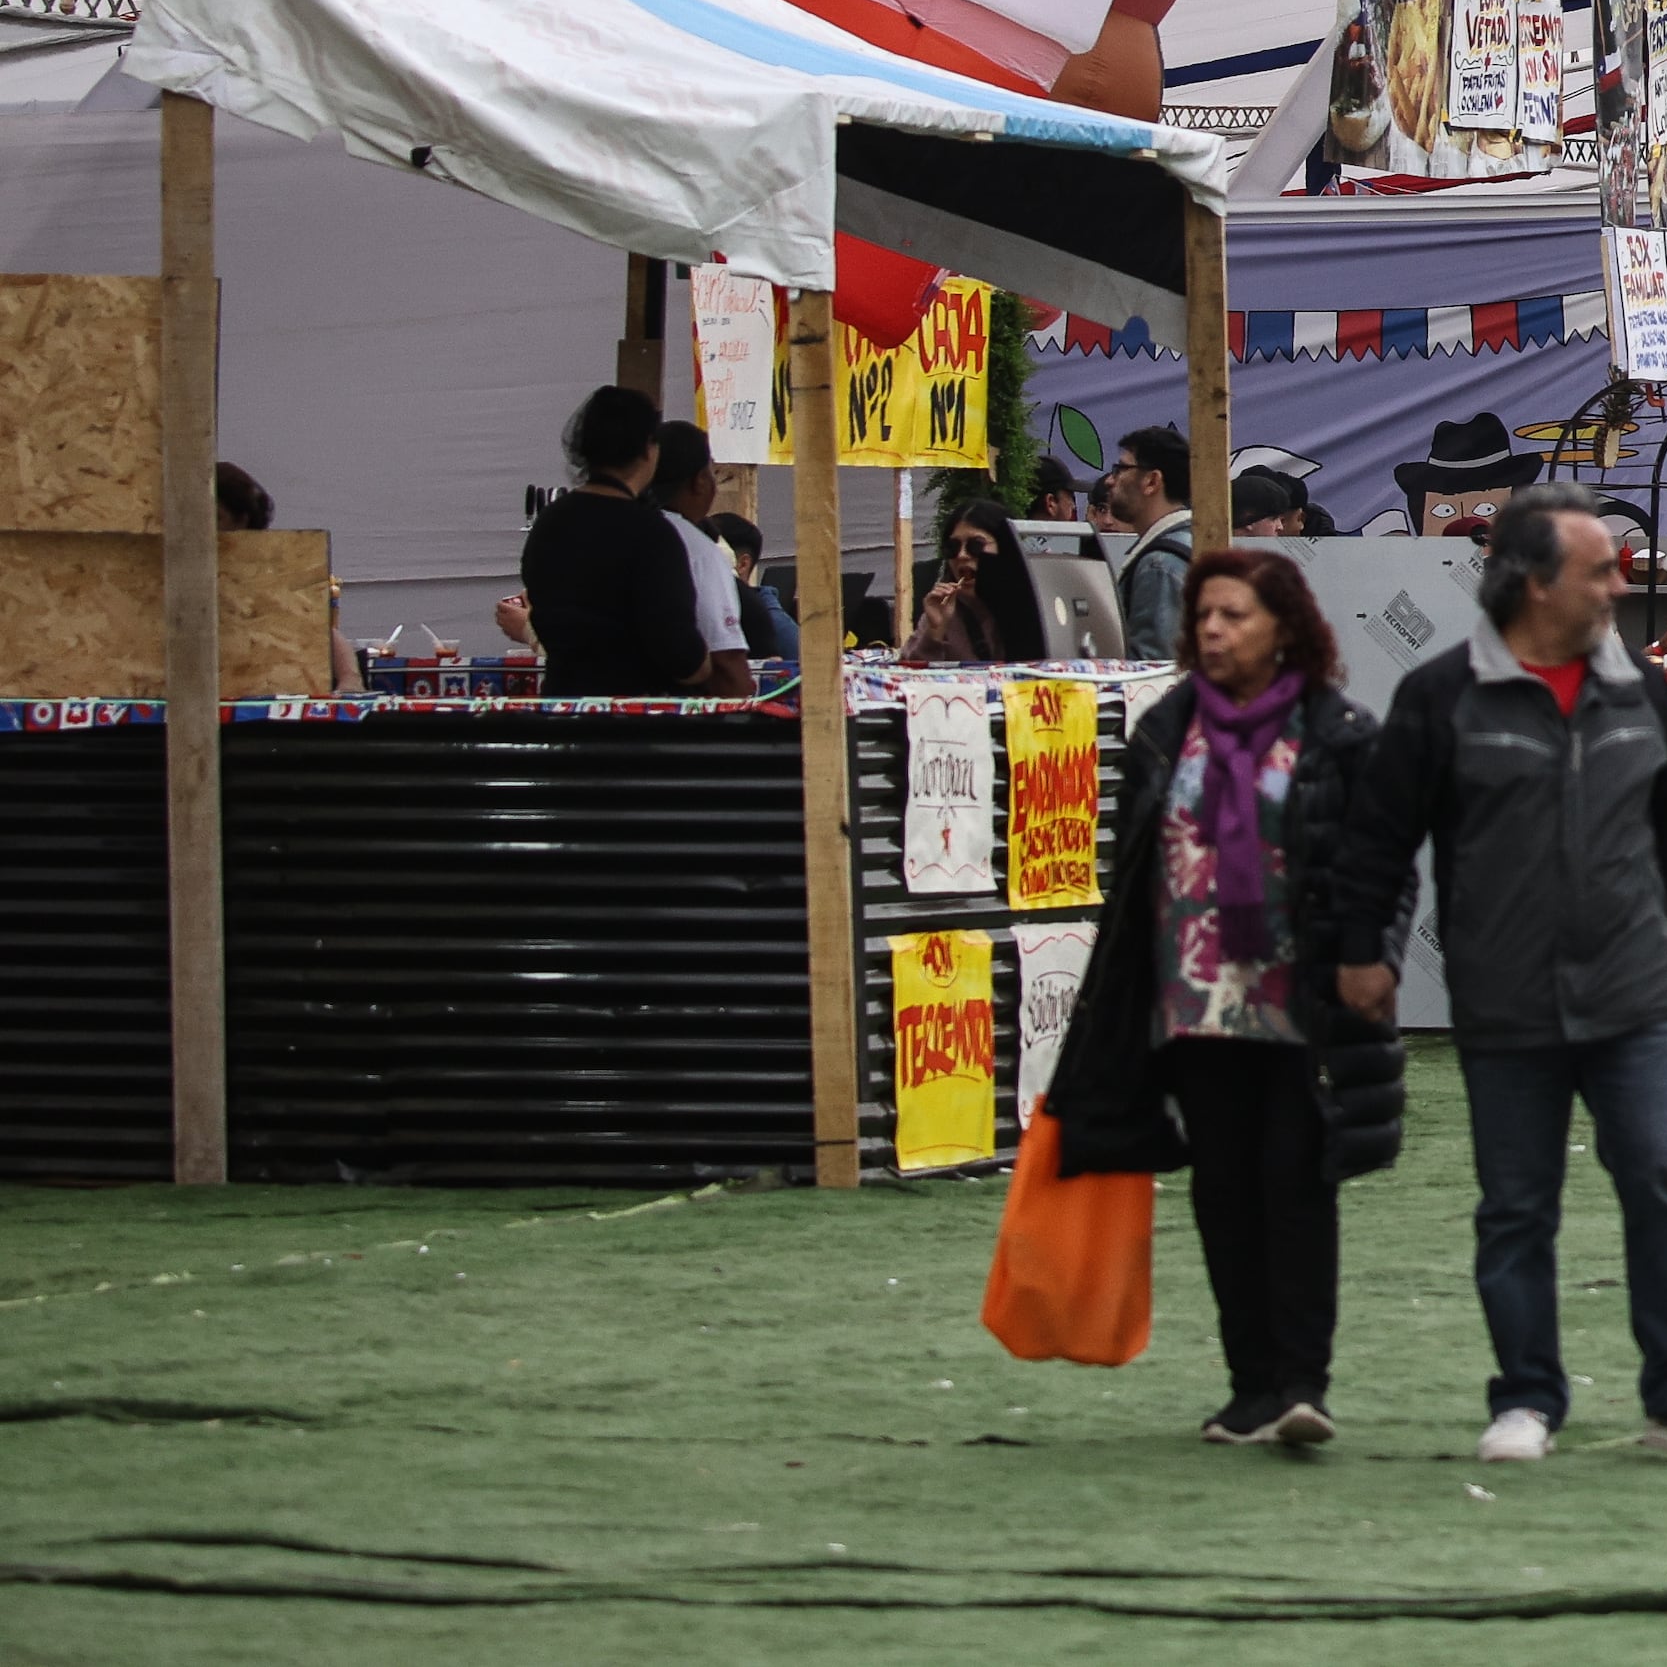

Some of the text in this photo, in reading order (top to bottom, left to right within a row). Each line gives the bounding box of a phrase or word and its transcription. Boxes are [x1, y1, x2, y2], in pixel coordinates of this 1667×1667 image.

[1465, 8, 1512, 50] VETADO
[1626, 234, 1652, 270] BOX
[1623, 271, 1667, 302] FAMILIAR
[918, 288, 987, 375] CAJA
[1382, 609, 1423, 652] TECNOMAT
[1417, 924, 1445, 956] TECNO
